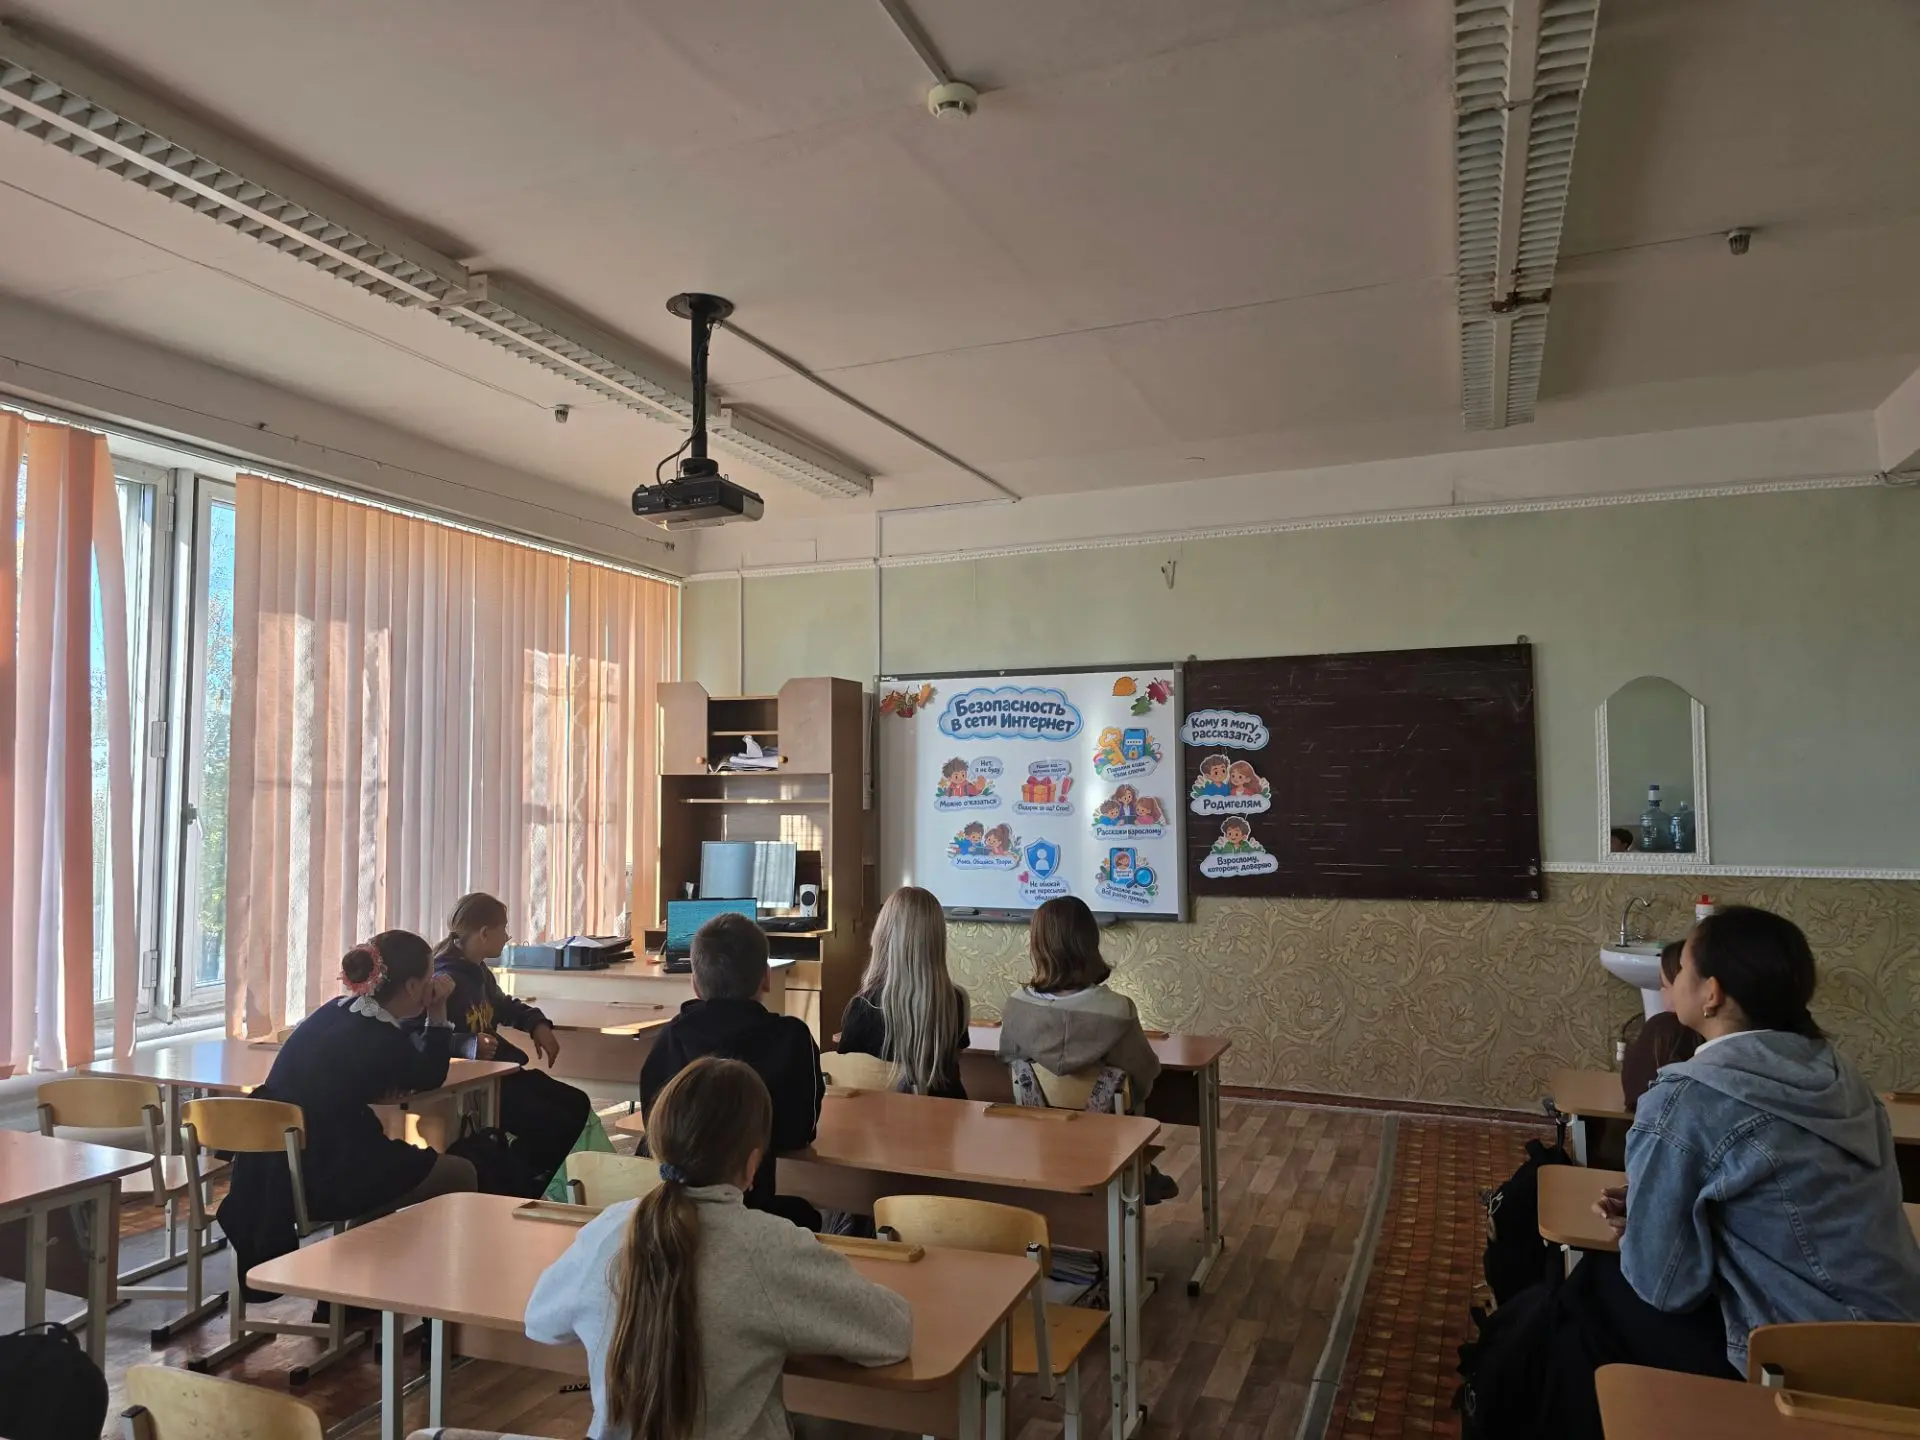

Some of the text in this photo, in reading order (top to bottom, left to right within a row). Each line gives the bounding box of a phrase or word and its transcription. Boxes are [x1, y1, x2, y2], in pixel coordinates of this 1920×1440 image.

[954, 699, 1066, 716] Безопасность
[964, 713, 997, 728] сети
[1000, 713, 1075, 732] Интернет
[1191, 717, 1259, 734] Кому я могу
[1192, 728, 1262, 744] рассказать?
[1203, 798, 1262, 811] Родителям
[1127, 827, 1162, 836] взрослому
